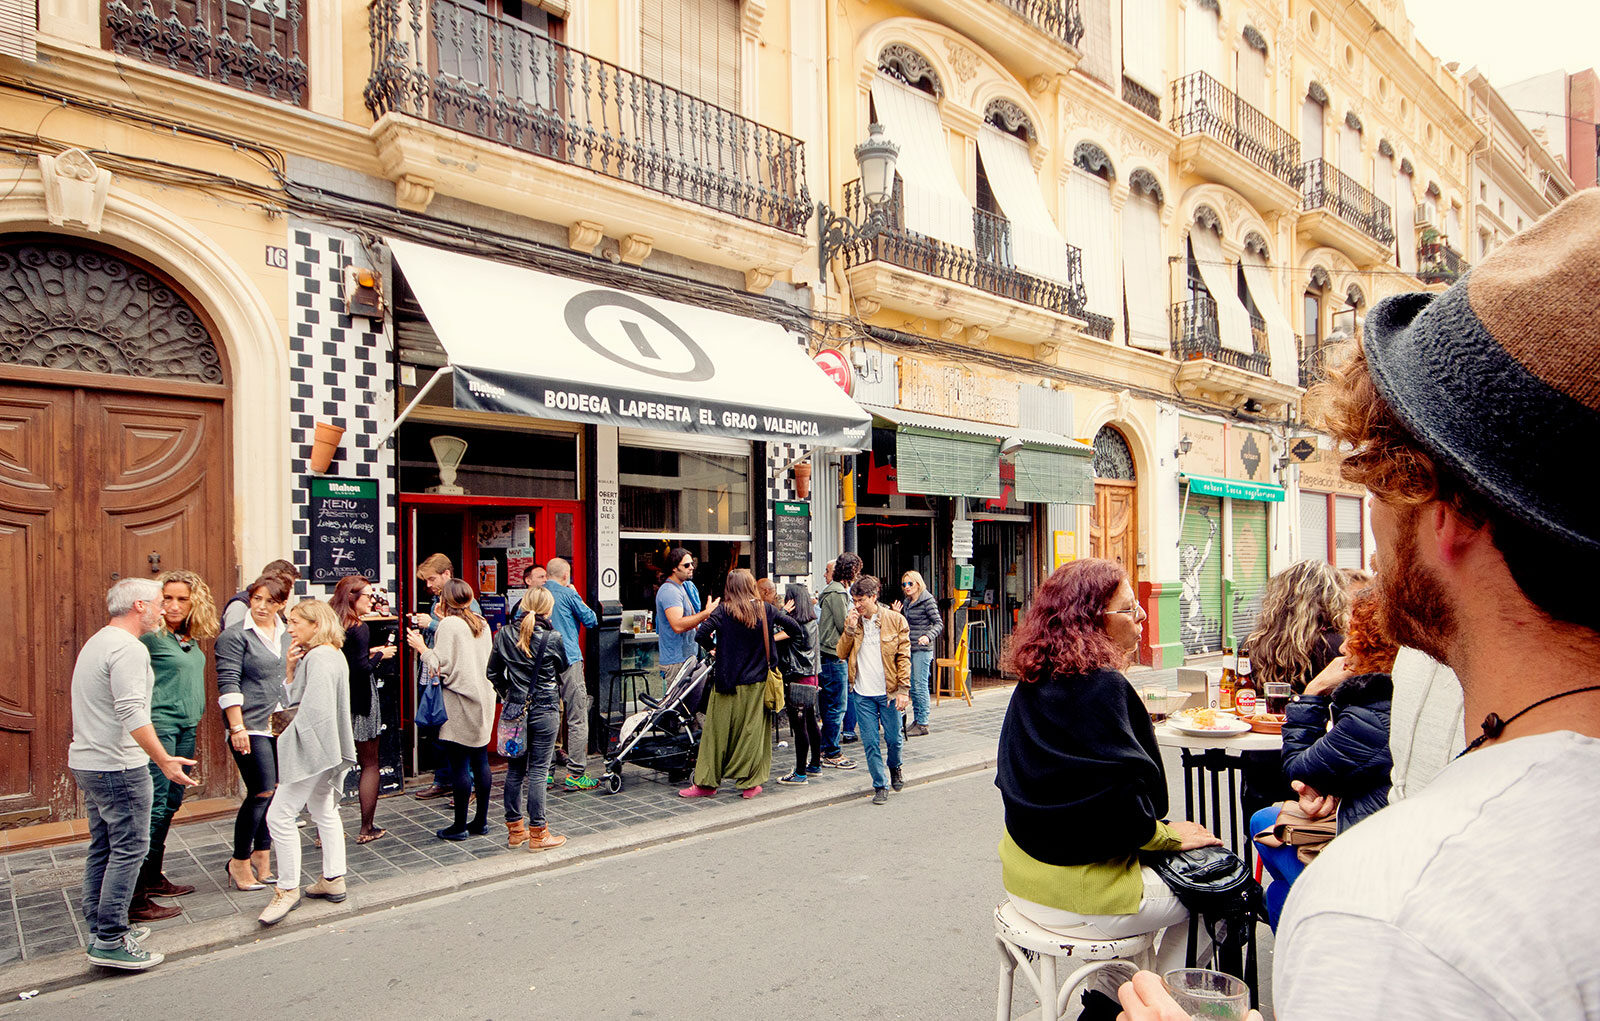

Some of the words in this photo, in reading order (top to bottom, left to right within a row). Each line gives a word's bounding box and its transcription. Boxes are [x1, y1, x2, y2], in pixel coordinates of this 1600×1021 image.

[267, 247, 287, 267] 16
[468, 380, 506, 396] Mahou
[544, 389, 612, 414] BODEGA
[619, 399, 692, 423] LAPESETA
[699, 408, 716, 425] EL
[722, 411, 757, 430] GRAO
[763, 415, 820, 437] VALENCIA
[329, 483, 360, 492] Mahou
[322, 499, 357, 509] MENU
[602, 498, 616, 506] TOTS
